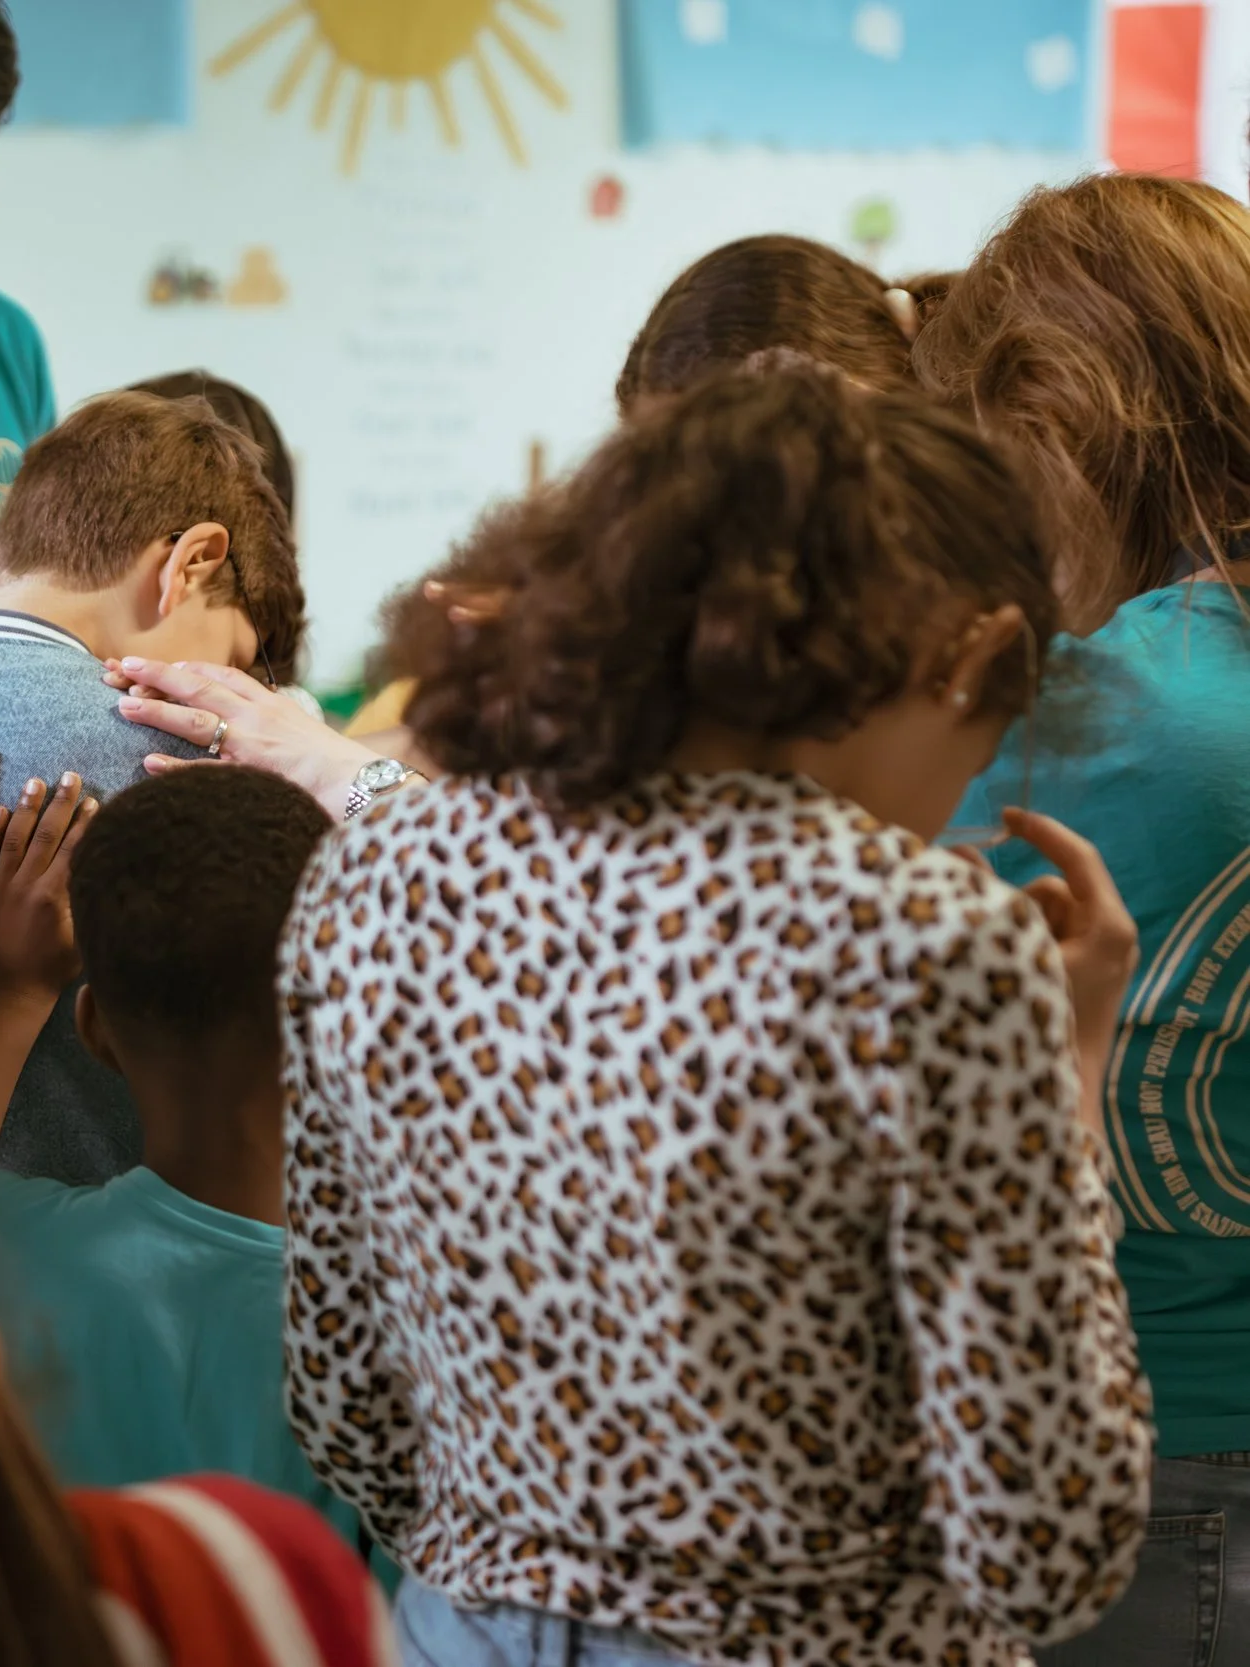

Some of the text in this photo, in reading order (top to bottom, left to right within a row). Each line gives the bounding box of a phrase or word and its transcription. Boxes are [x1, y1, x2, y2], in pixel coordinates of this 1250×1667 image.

[1183, 957, 1223, 1006] HAVE
[1171, 1005, 1201, 1029] UT
[1139, 1081, 1164, 1115] NOT
